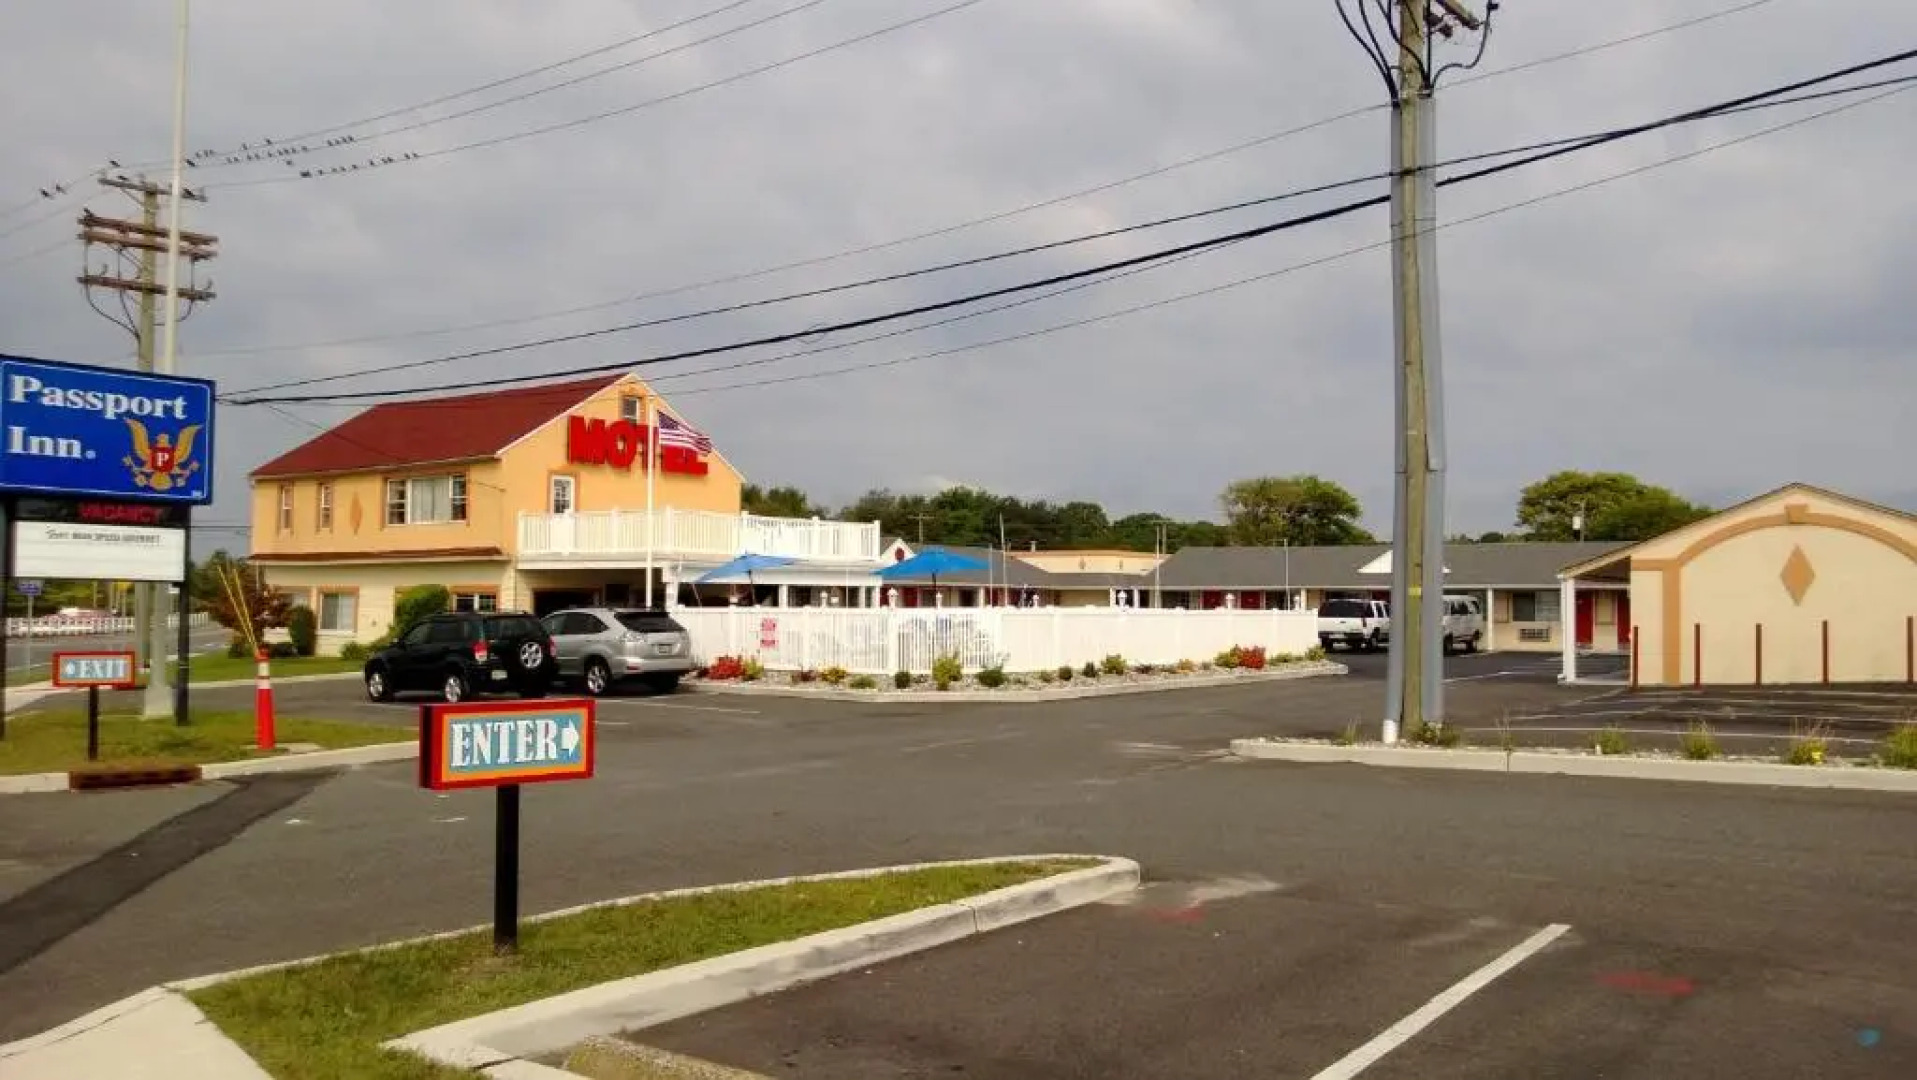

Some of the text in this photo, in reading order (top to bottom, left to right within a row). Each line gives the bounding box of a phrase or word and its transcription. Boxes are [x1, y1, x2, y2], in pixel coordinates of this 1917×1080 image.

[8, 373, 188, 420] Passport
[8, 426, 97, 459] Inn.
[156, 452, 170, 467] P
[568, 415, 709, 475] MOTEL
[80, 660, 125, 679] EXIT
[450, 719, 558, 767] ENTER
